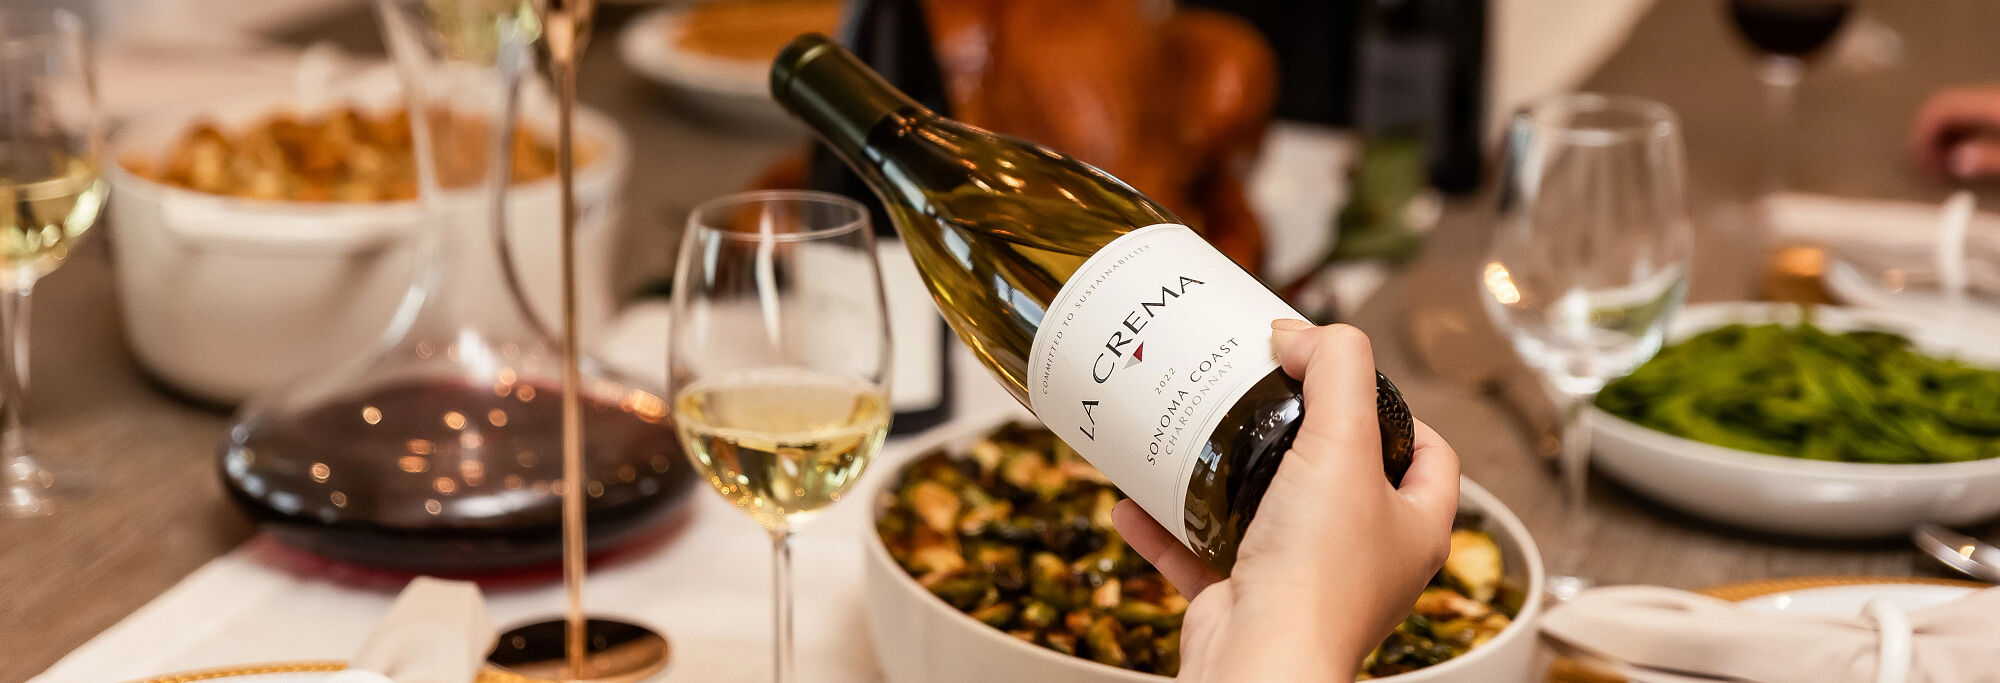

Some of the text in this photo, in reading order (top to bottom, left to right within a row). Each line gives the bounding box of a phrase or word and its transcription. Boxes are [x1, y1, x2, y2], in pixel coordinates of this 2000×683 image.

[1042, 243, 1151, 396] COMMITTED TO SUSTAINABILITY
[1079, 276, 1205, 442] LA CREMA
[1155, 367, 1177, 396] 2022
[1146, 337, 1240, 466] SONOMA COAST
[1165, 361, 1234, 456] CHARDONNAY
